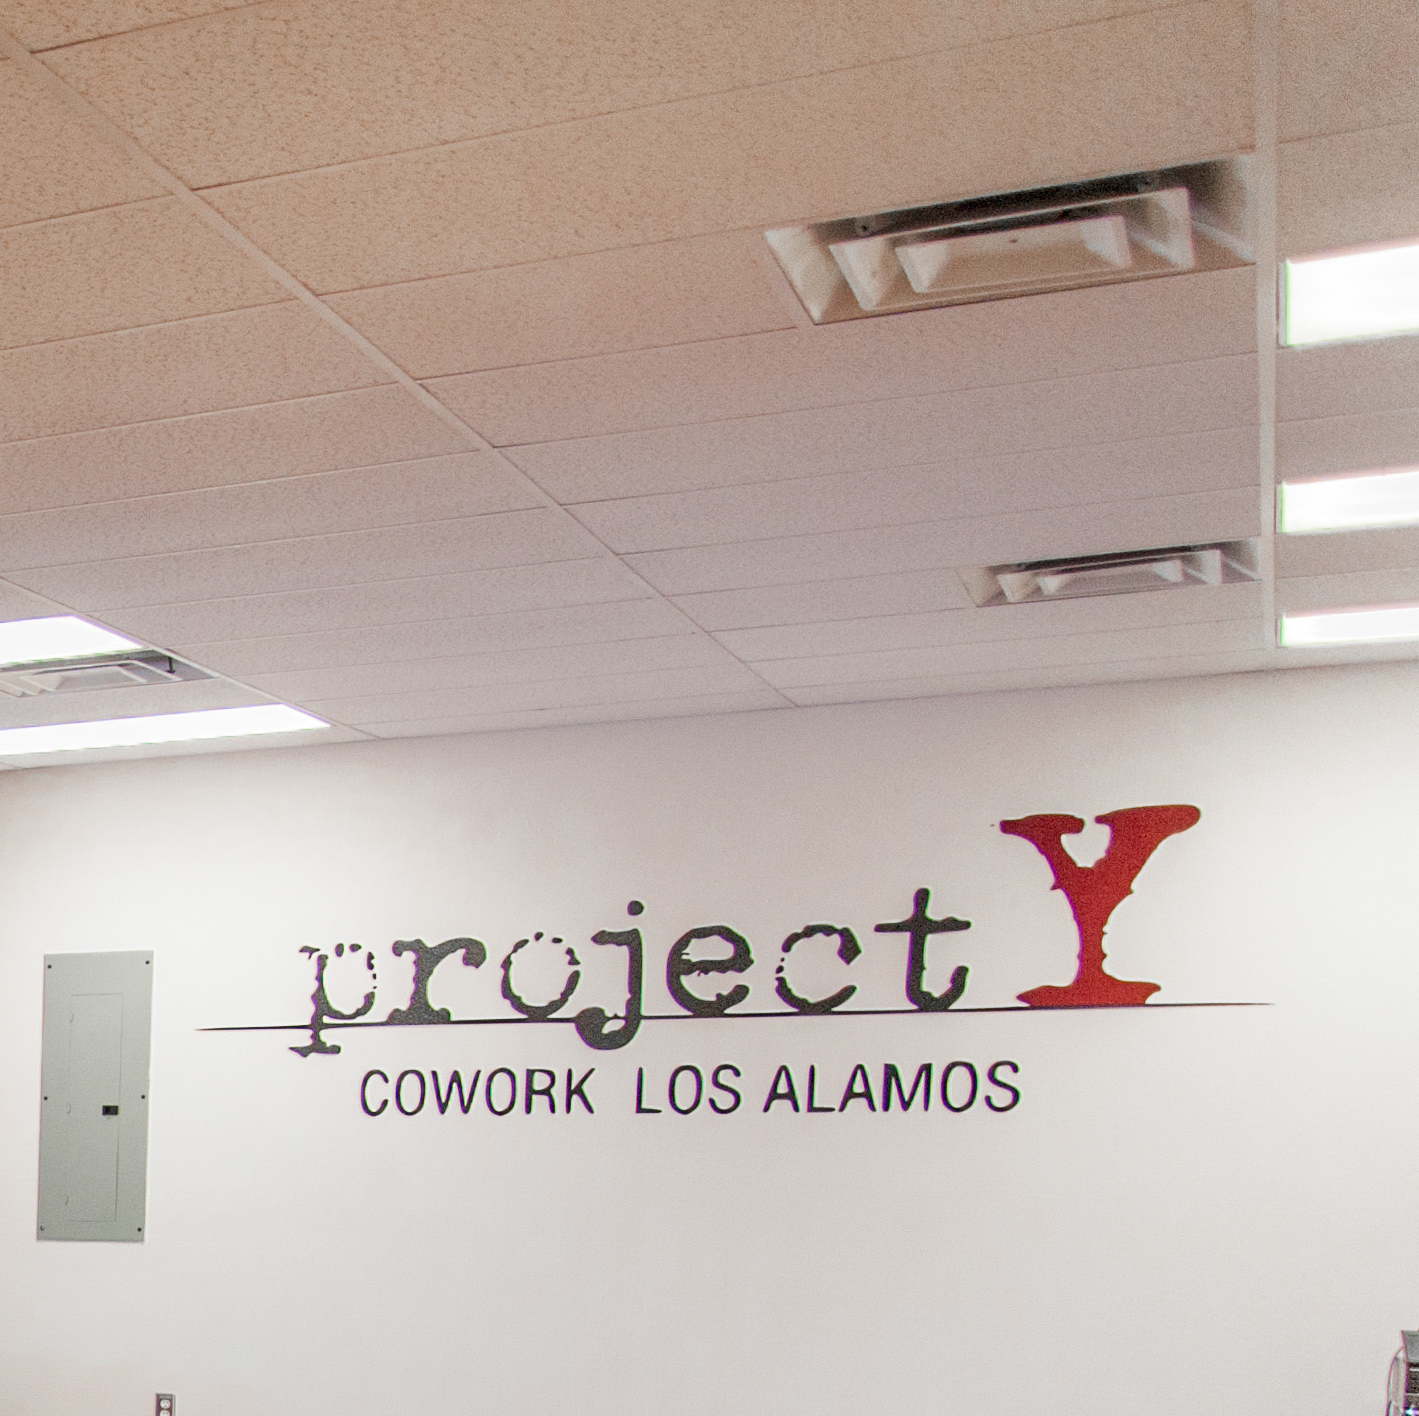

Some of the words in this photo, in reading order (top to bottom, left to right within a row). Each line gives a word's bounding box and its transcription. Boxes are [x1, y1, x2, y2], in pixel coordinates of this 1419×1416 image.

[288, 886, 972, 1058] project
[999, 803, 1201, 1007] Y
[359, 1067, 596, 1117] COWORK
[635, 1064, 741, 1116] LOS
[762, 1060, 1021, 1113] ALAMOS
